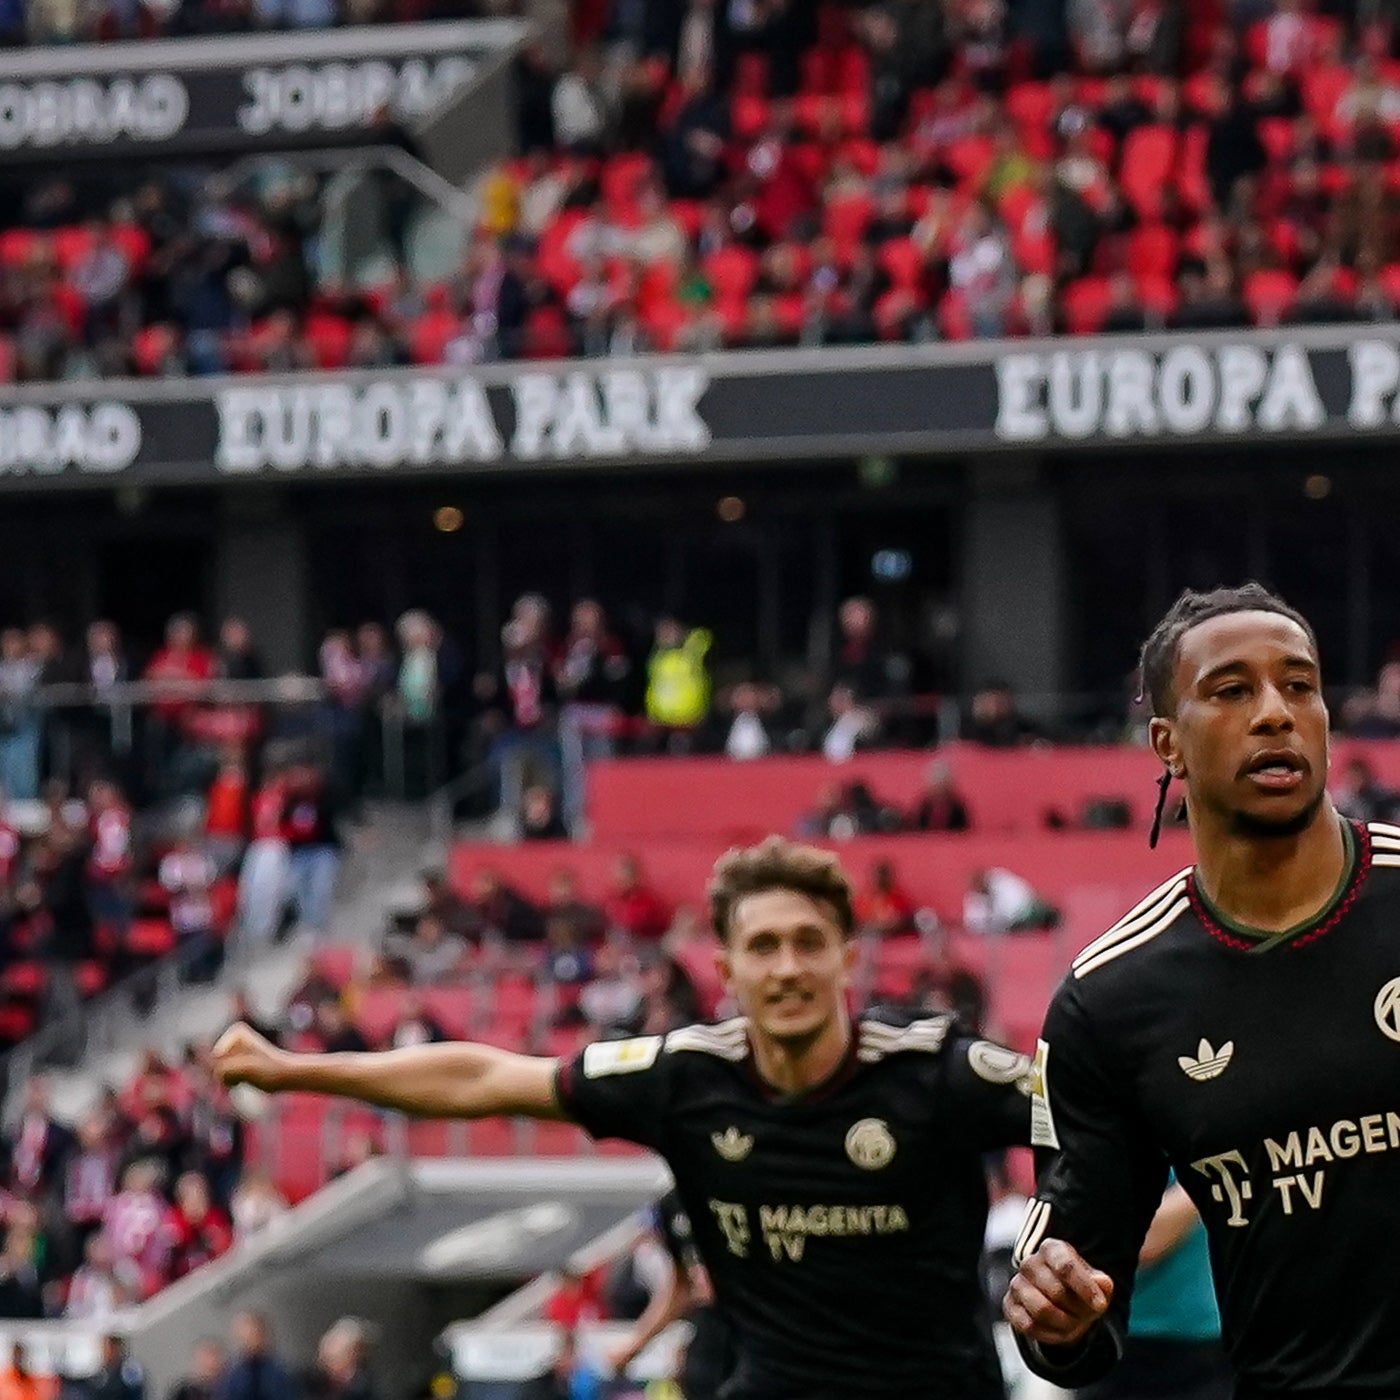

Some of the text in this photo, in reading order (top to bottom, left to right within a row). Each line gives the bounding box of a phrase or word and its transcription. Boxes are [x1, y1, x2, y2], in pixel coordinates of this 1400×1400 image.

[215, 366, 713, 474] EUROPA PARK
[994, 342, 1326, 441] EUROPA
[759, 1204, 909, 1236] MAGENTA
[1272, 1170, 1326, 1216] TV
